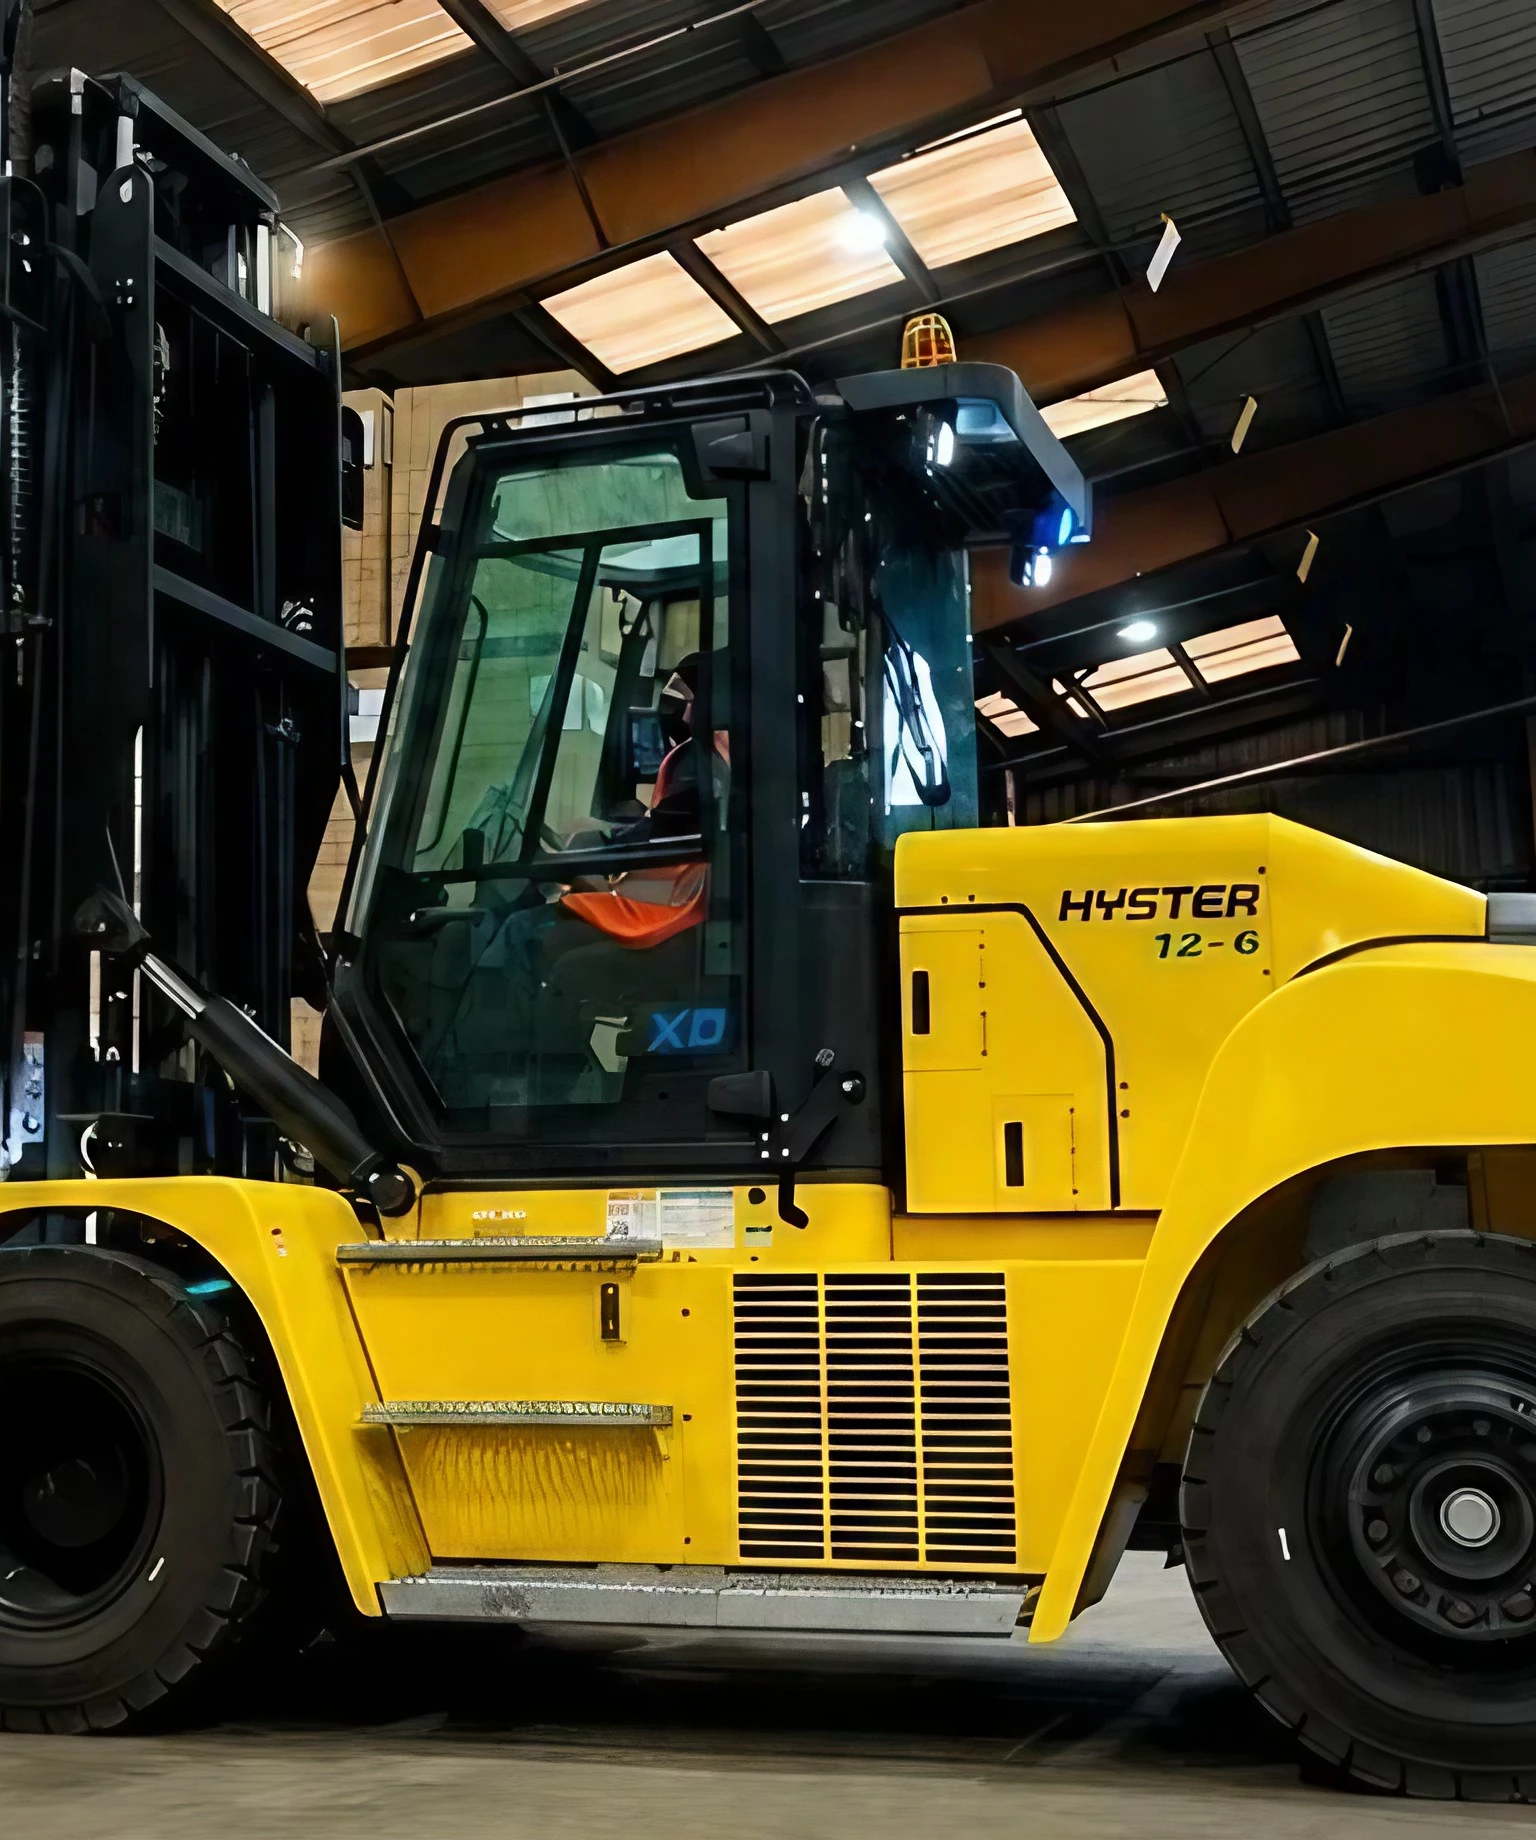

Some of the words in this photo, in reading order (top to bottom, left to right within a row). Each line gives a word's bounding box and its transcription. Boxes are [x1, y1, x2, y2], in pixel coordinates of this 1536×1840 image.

[1058, 884, 1260, 922] HYSTER
[1155, 930, 1260, 959] 12-6
[647, 1008, 726, 1052] XD
